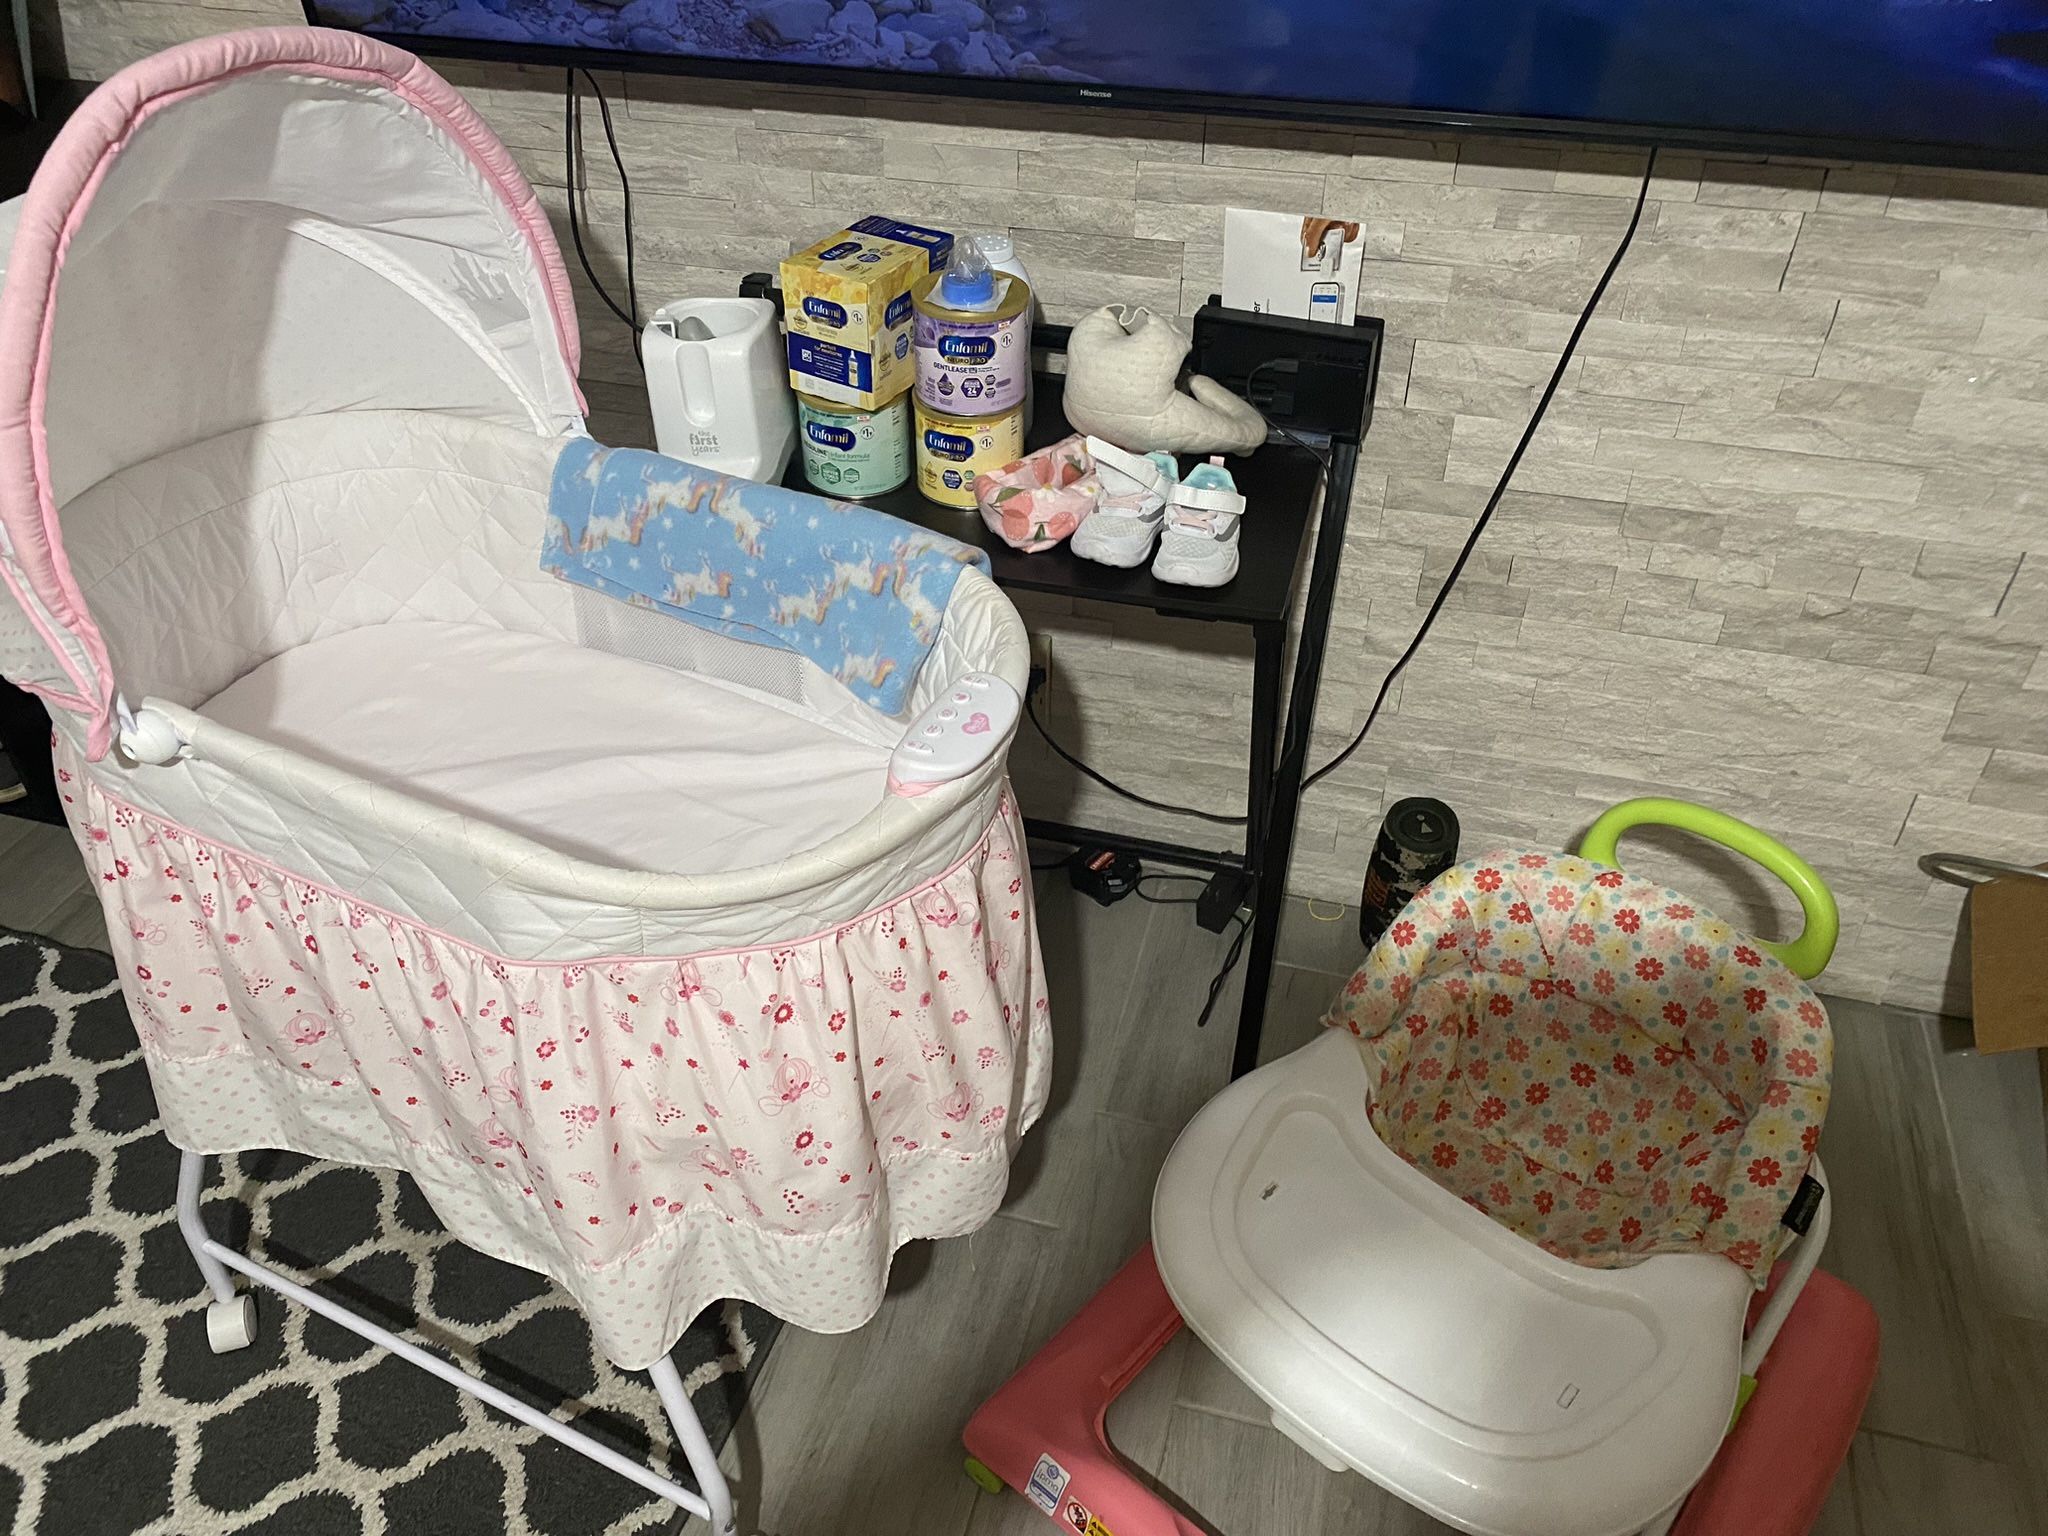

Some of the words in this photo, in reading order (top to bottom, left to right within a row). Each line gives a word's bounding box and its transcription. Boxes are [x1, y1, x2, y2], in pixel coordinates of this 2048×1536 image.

[1080, 89, 1112, 98] Hisense
[945, 340, 989, 354] Enfamil
[810, 424, 849, 444] Enfamil
[929, 434, 967, 451] Enfamil
[691, 446, 720, 457] years
